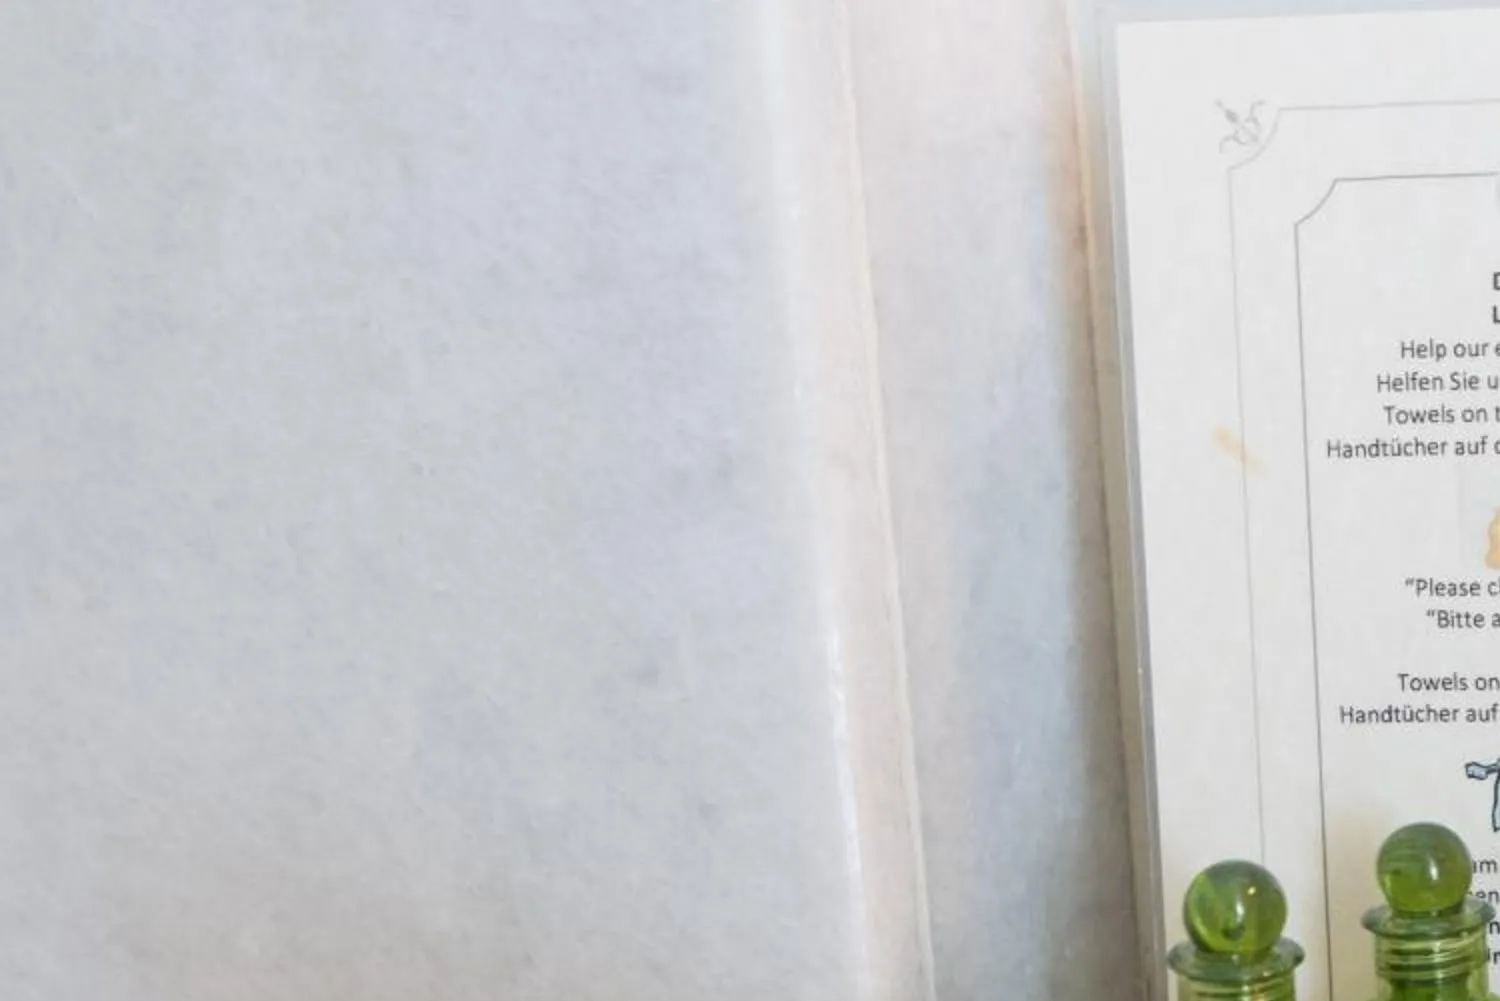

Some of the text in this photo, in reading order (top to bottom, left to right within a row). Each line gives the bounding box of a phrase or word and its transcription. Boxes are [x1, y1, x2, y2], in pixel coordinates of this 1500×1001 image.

[1400, 339, 1447, 362] Help
[1453, 341, 1489, 358] our
[1377, 372, 1444, 392] Helfen
[1450, 371, 1480, 391] Sie
[1384, 405, 1455, 425] Towels
[1463, 407, 1488, 424] on
[1327, 438, 1447, 460] Handtücher
[1454, 436, 1488, 456] auf
[1398, 672, 1468, 692] Towels
[1475, 675, 1500, 692] on
[1340, 703, 1459, 724] Handtücher
[1466, 702, 1498, 722] auf
